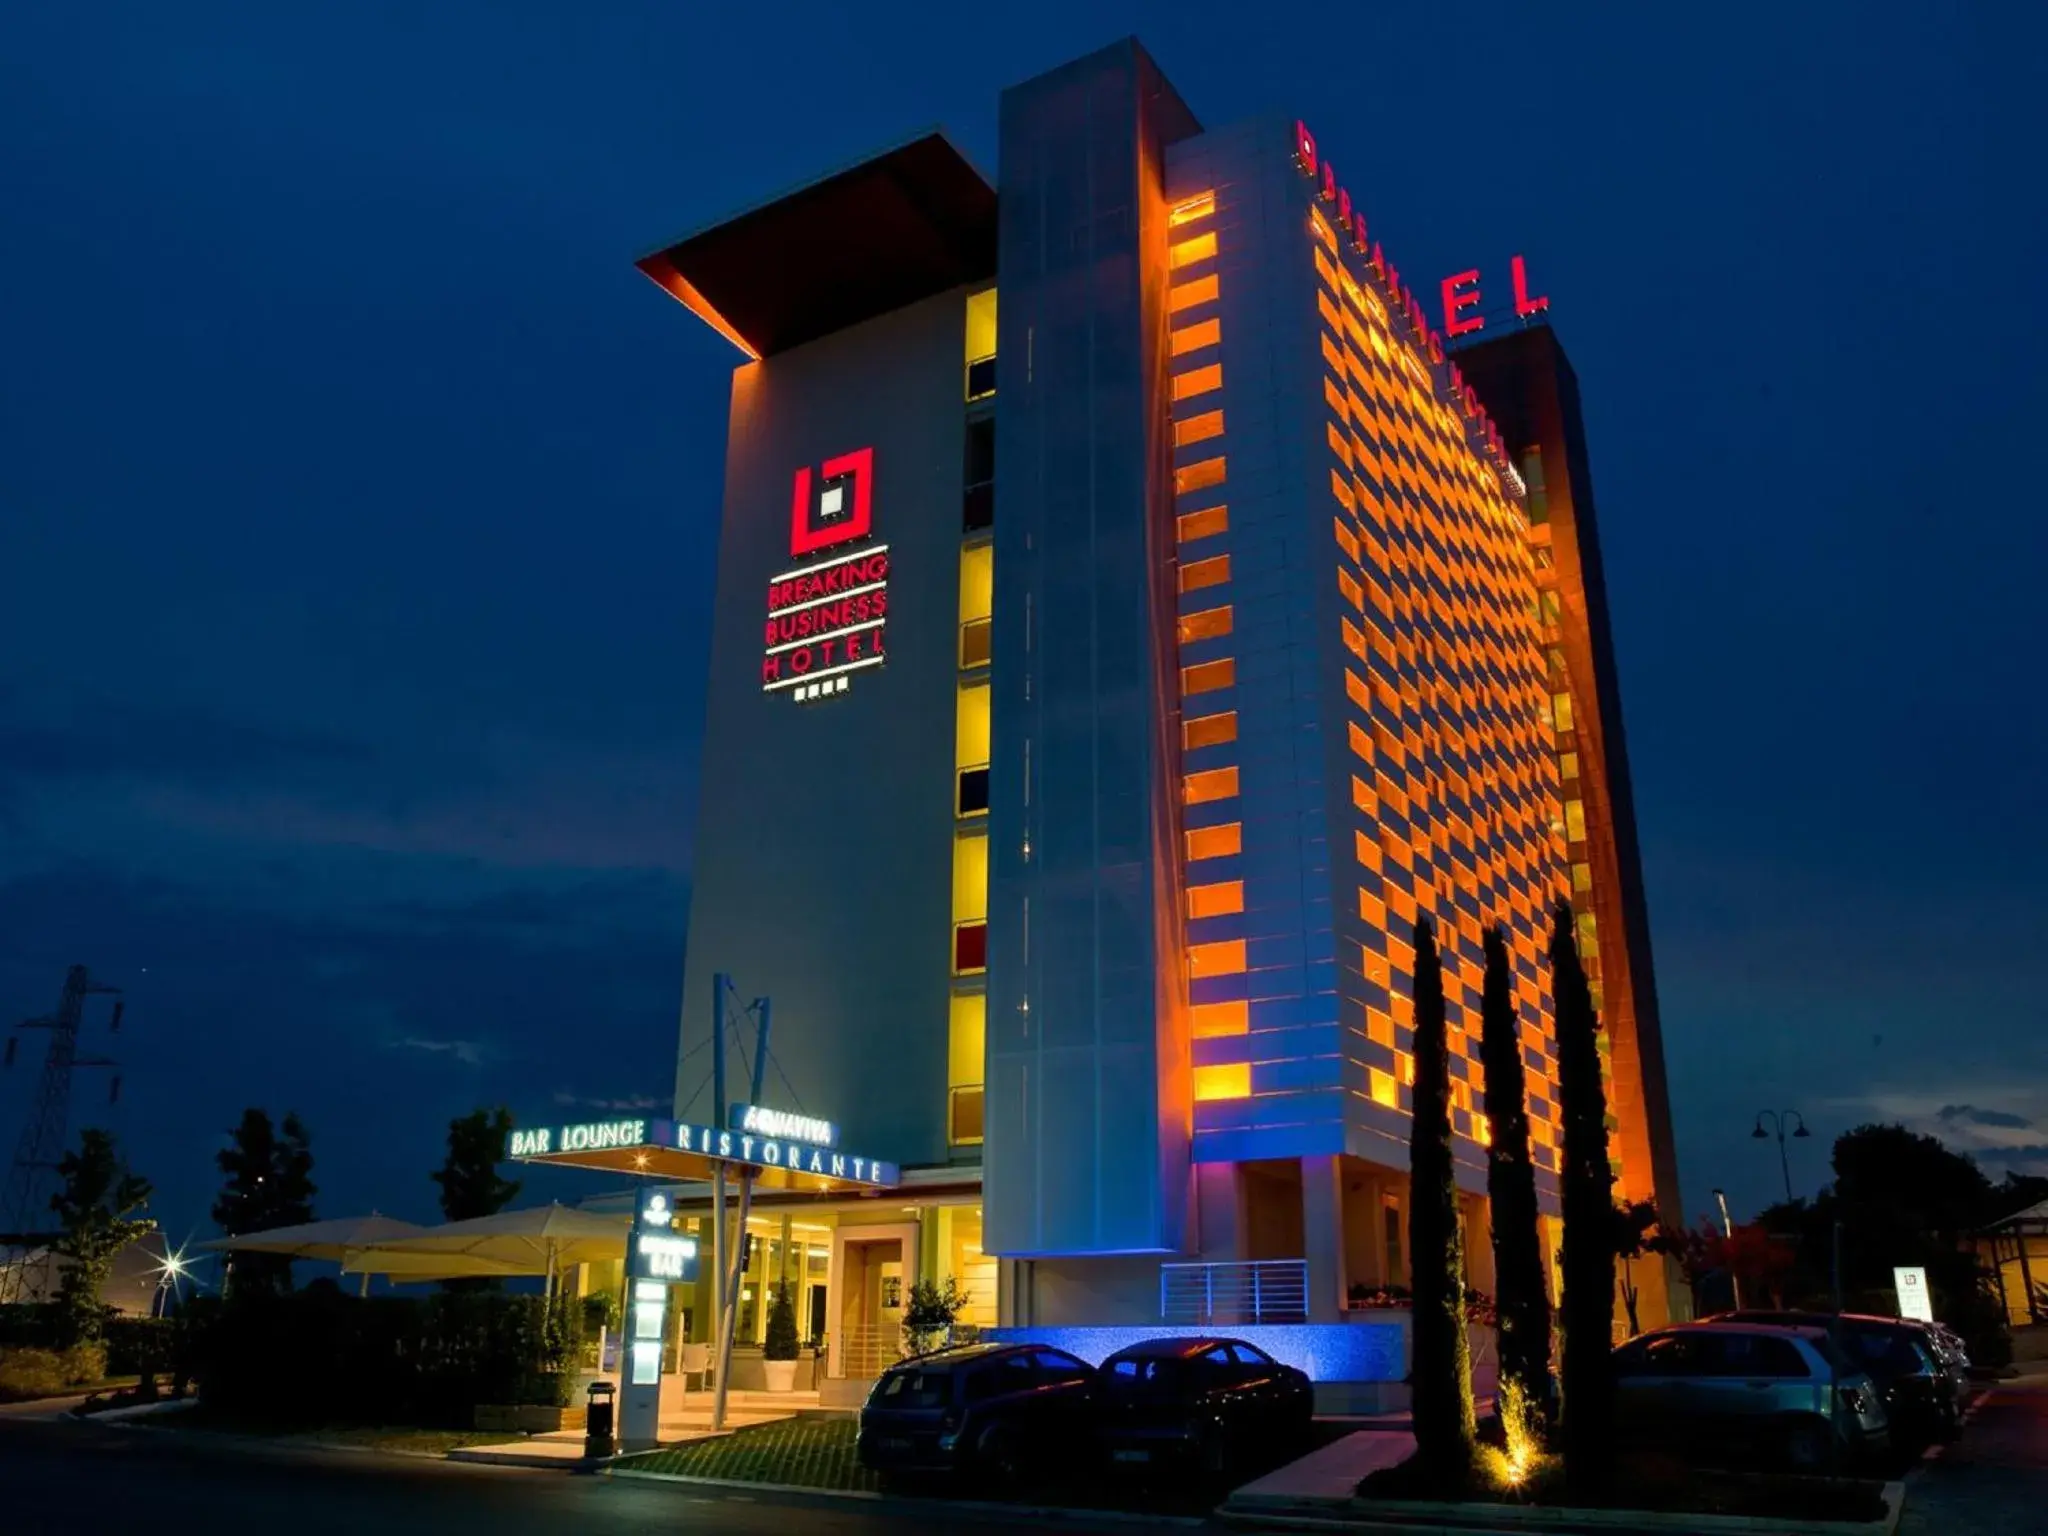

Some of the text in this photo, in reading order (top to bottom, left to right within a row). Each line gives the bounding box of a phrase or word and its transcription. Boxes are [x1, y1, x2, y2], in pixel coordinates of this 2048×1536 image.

[768, 555, 887, 608] BREAKING
[764, 592, 886, 644] BUSINESS
[763, 630, 883, 680] HOTEL
[511, 1119, 645, 1156] BAR LOUNGE
[678, 1124, 881, 1182] RISTORANTE
